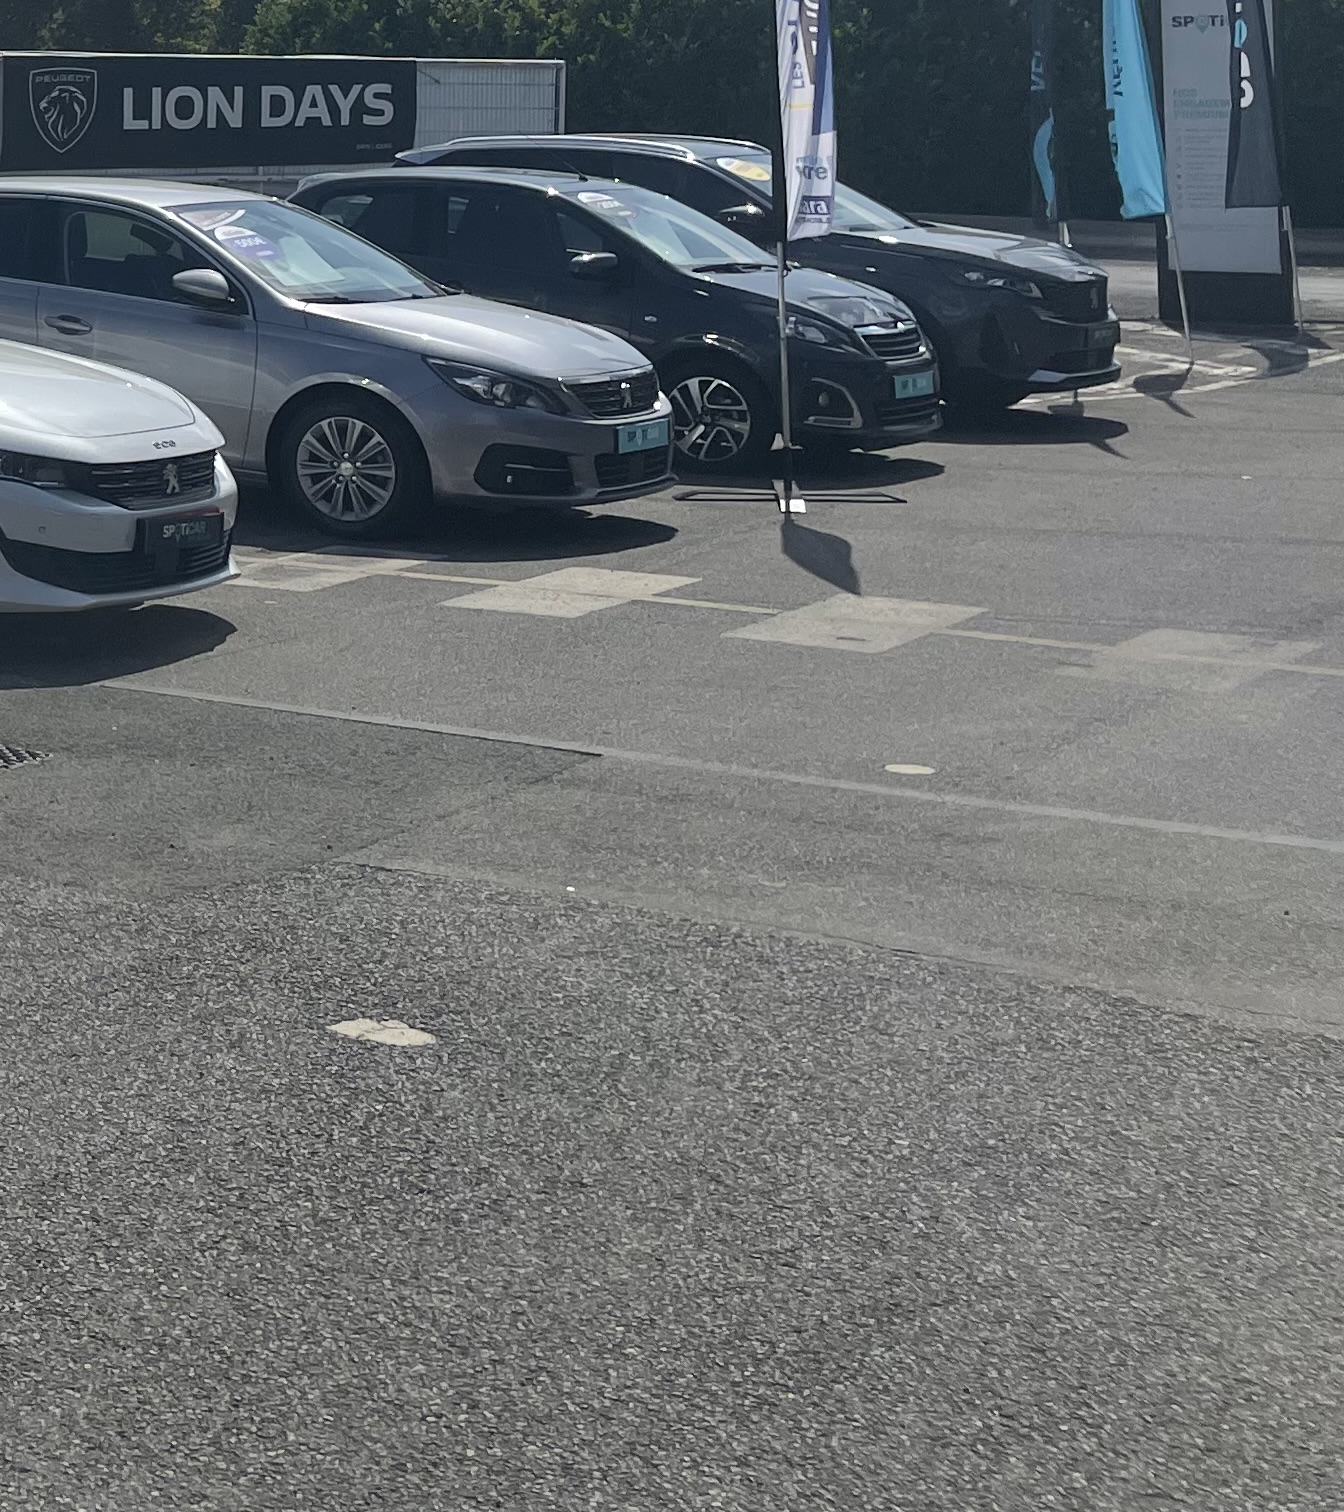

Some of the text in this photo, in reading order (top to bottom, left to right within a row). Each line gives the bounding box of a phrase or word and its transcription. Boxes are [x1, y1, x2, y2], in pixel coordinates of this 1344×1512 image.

[1171, 15, 1226, 34] SPOTi
[35, 74, 92, 83] PEUGEOT
[122, 83, 395, 130] LION DAYS
